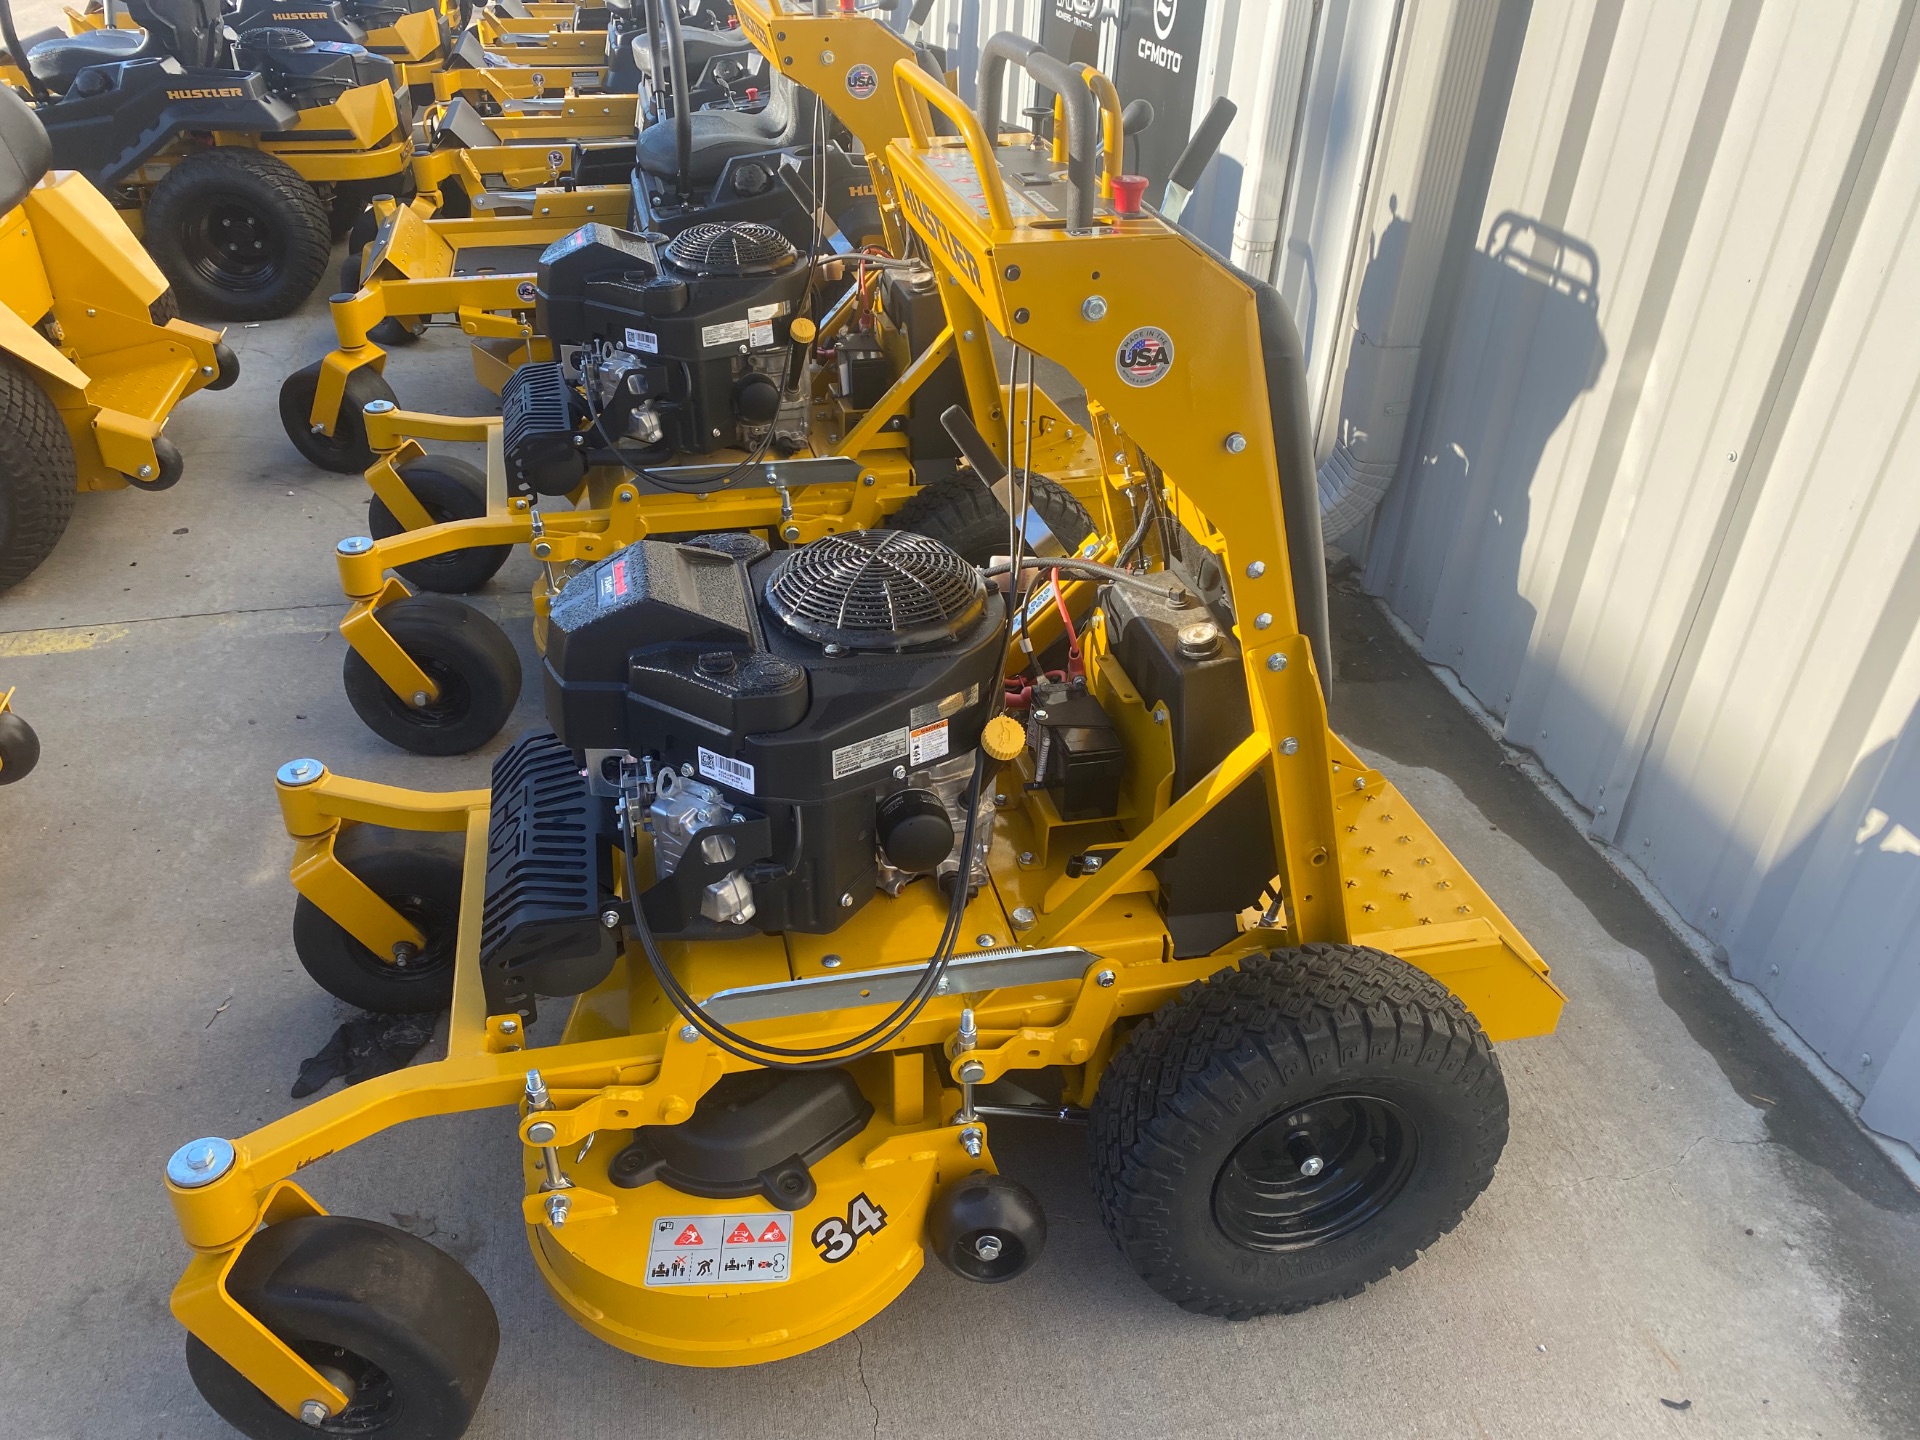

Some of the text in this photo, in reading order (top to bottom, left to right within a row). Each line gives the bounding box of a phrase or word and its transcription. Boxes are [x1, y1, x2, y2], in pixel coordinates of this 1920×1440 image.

[271, 12, 328, 20] HUSTLER
[1137, 37, 1182, 74] CFMOTO
[847, 76, 876, 88] USA
[166, 87, 243, 100] HUSTLER
[898, 176, 985, 297] HUSTLER
[1124, 331, 1144, 349] MADE
[1156, 333, 1168, 346] THE
[1119, 346, 1170, 368] USA
[811, 1191, 888, 1264] 34
